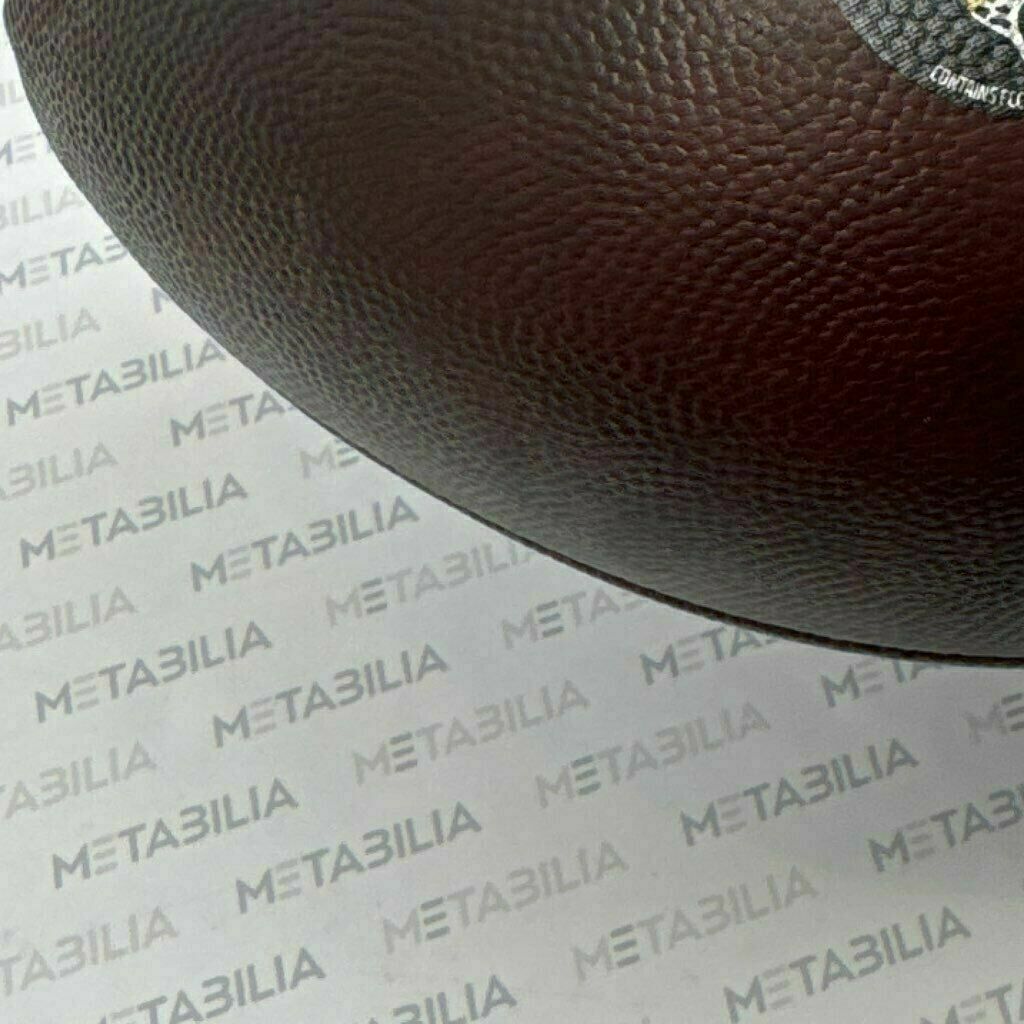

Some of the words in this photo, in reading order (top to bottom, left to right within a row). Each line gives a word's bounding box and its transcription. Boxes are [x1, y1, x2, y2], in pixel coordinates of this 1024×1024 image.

[929, 64, 998, 104] CONTAINS
[999, 89, 1024, 109] FCC
[20, 473, 248, 569] METABILIA
[191, 496, 420, 592] METABILIA
[326, 544, 531, 628] METABILI
[35, 622, 272, 723] METABILIA
[213, 645, 449, 748] METABILIA
[53, 778, 299, 890] METABILIA
[236, 802, 482, 914] METABILIA
